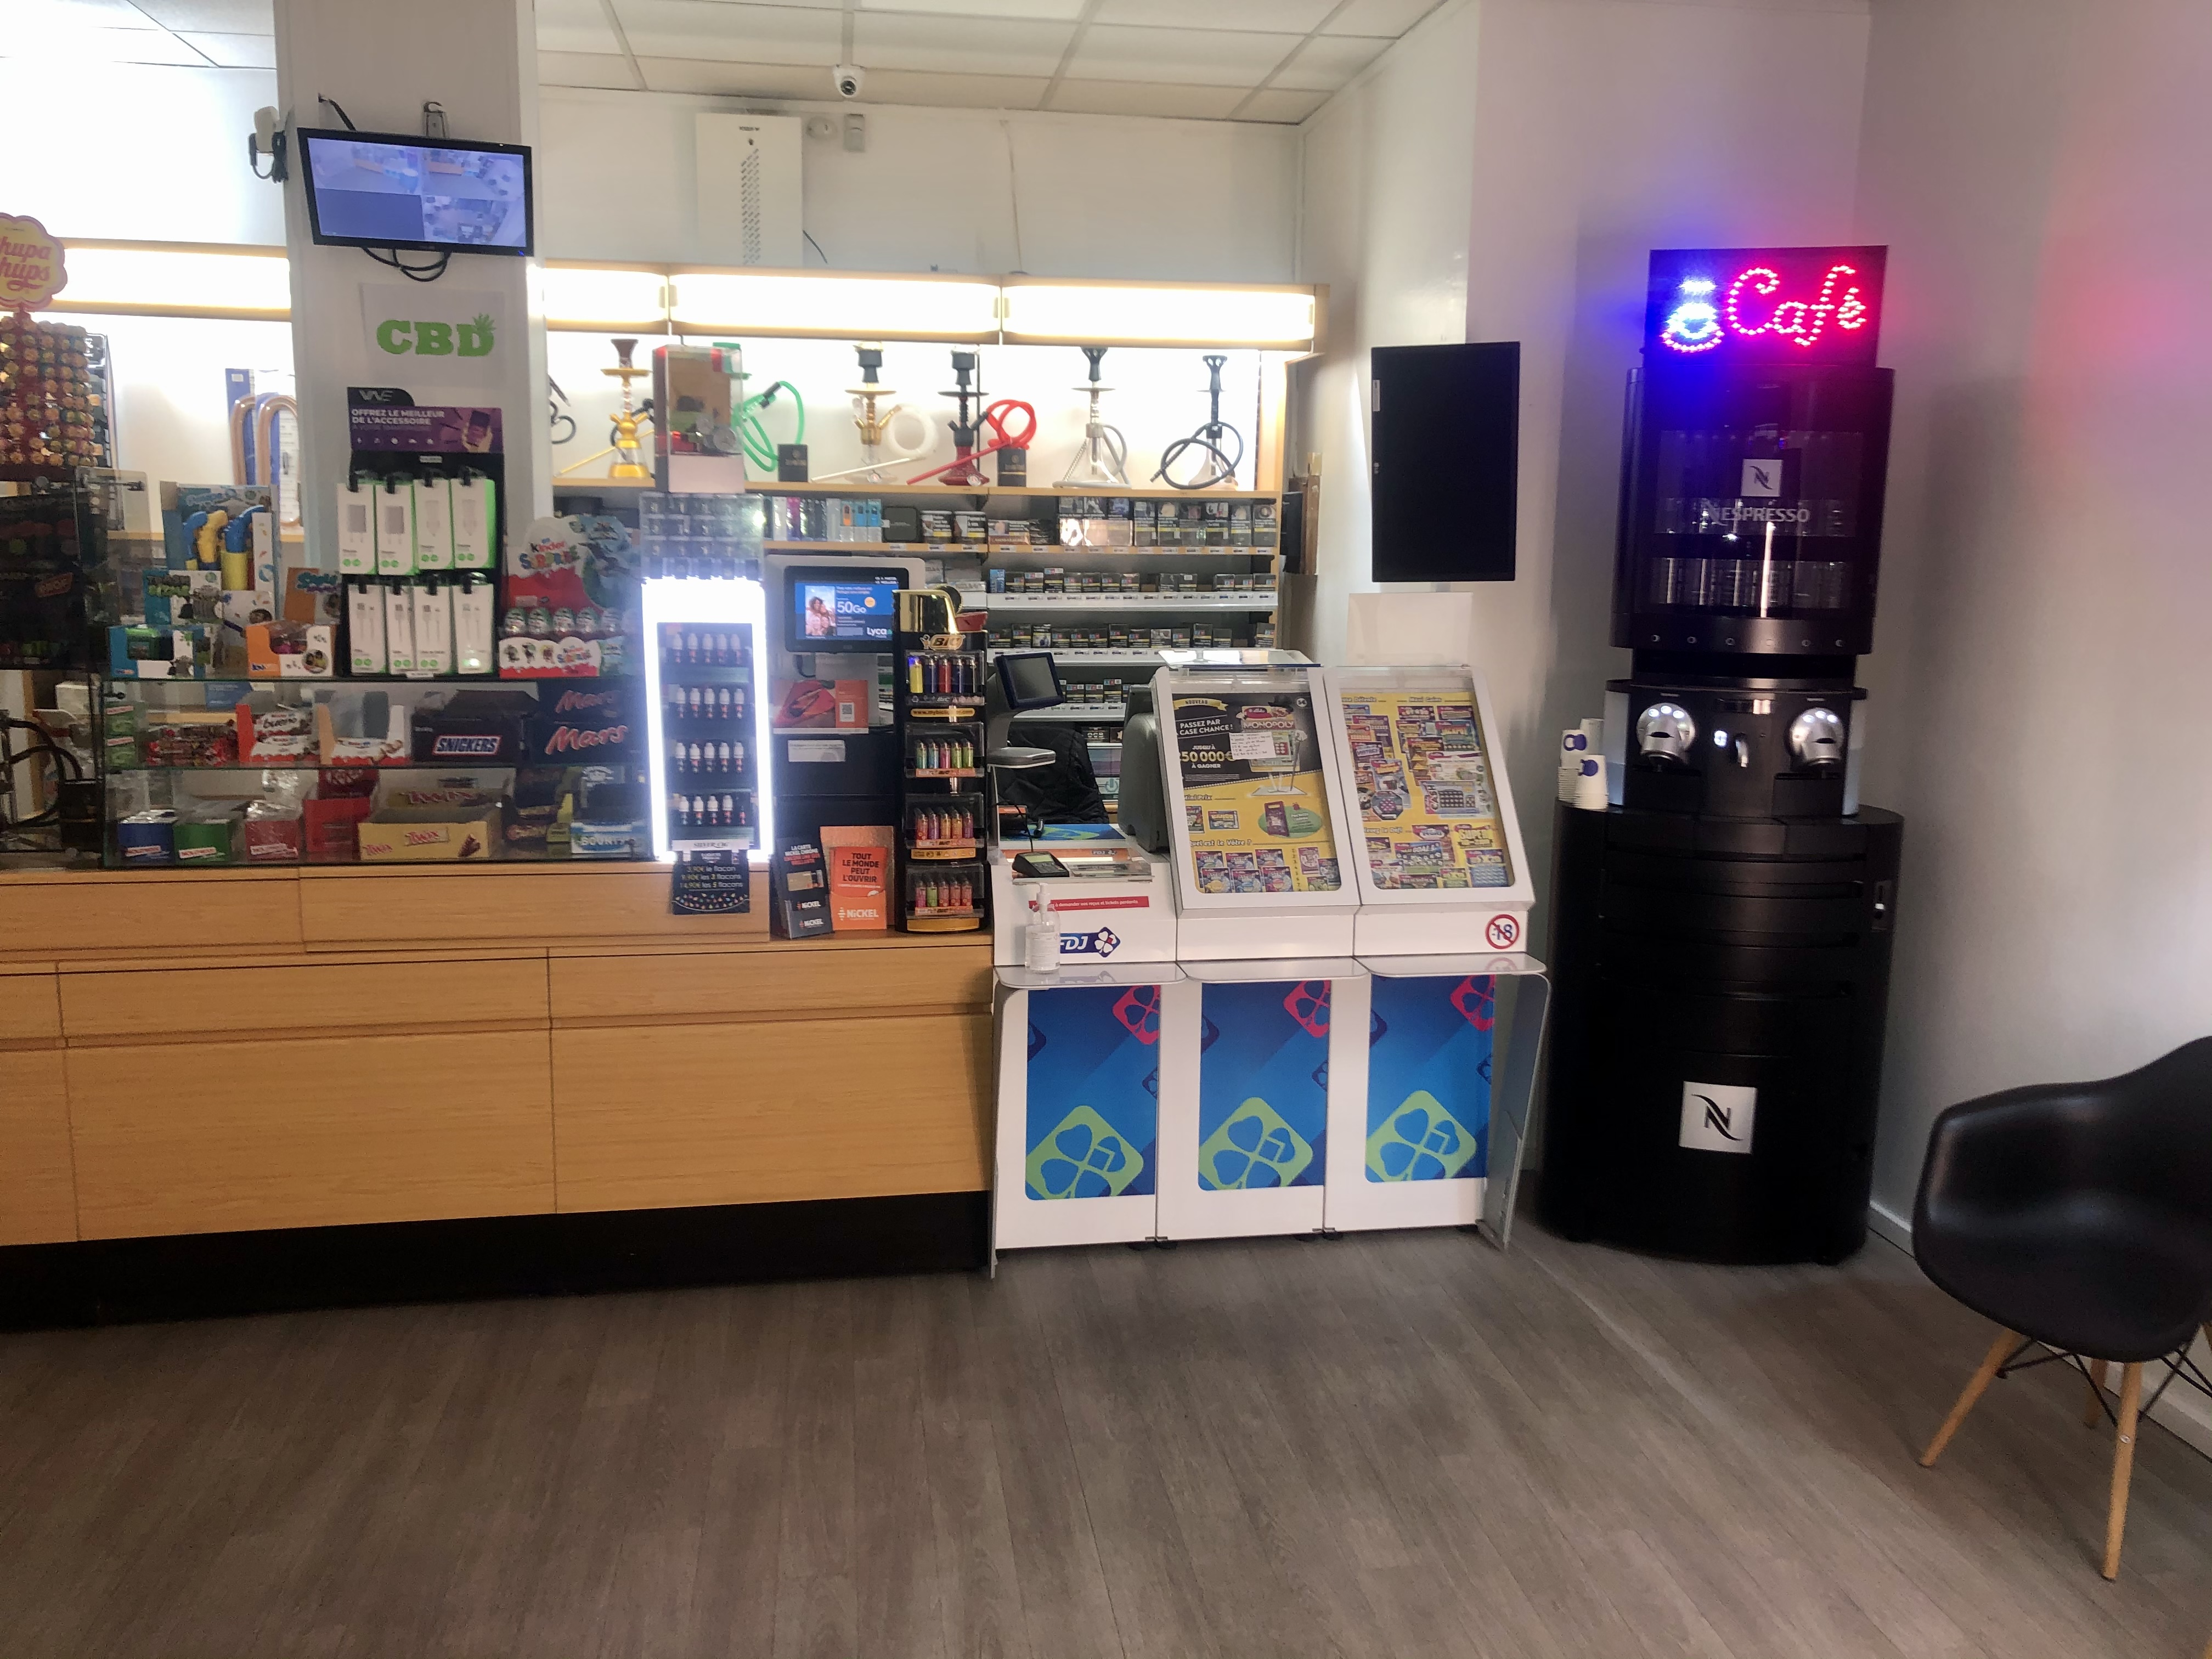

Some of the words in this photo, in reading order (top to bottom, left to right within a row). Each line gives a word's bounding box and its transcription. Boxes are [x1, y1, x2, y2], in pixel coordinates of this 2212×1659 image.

[0, 236, 52, 263] hupa
[0, 261, 51, 283] hups
[377, 319, 495, 357] CBD
[351, 409, 387, 417] OFFREZ
[401, 410, 445, 418] MEILLEUR
[366, 417, 432, 425] L'ACCESSOIRE
[1701, 498, 1810, 526] NESPRESSO
[867, 627, 887, 636] Lyca
[933, 637, 960, 647] BIC
[1180, 720, 1206, 729] PASSEZ
[1199, 725, 1229, 733] CHANCE
[437, 738, 498, 752] SNICKERS
[544, 725, 628, 755] Mars
[1180, 751, 1198, 762] 50
